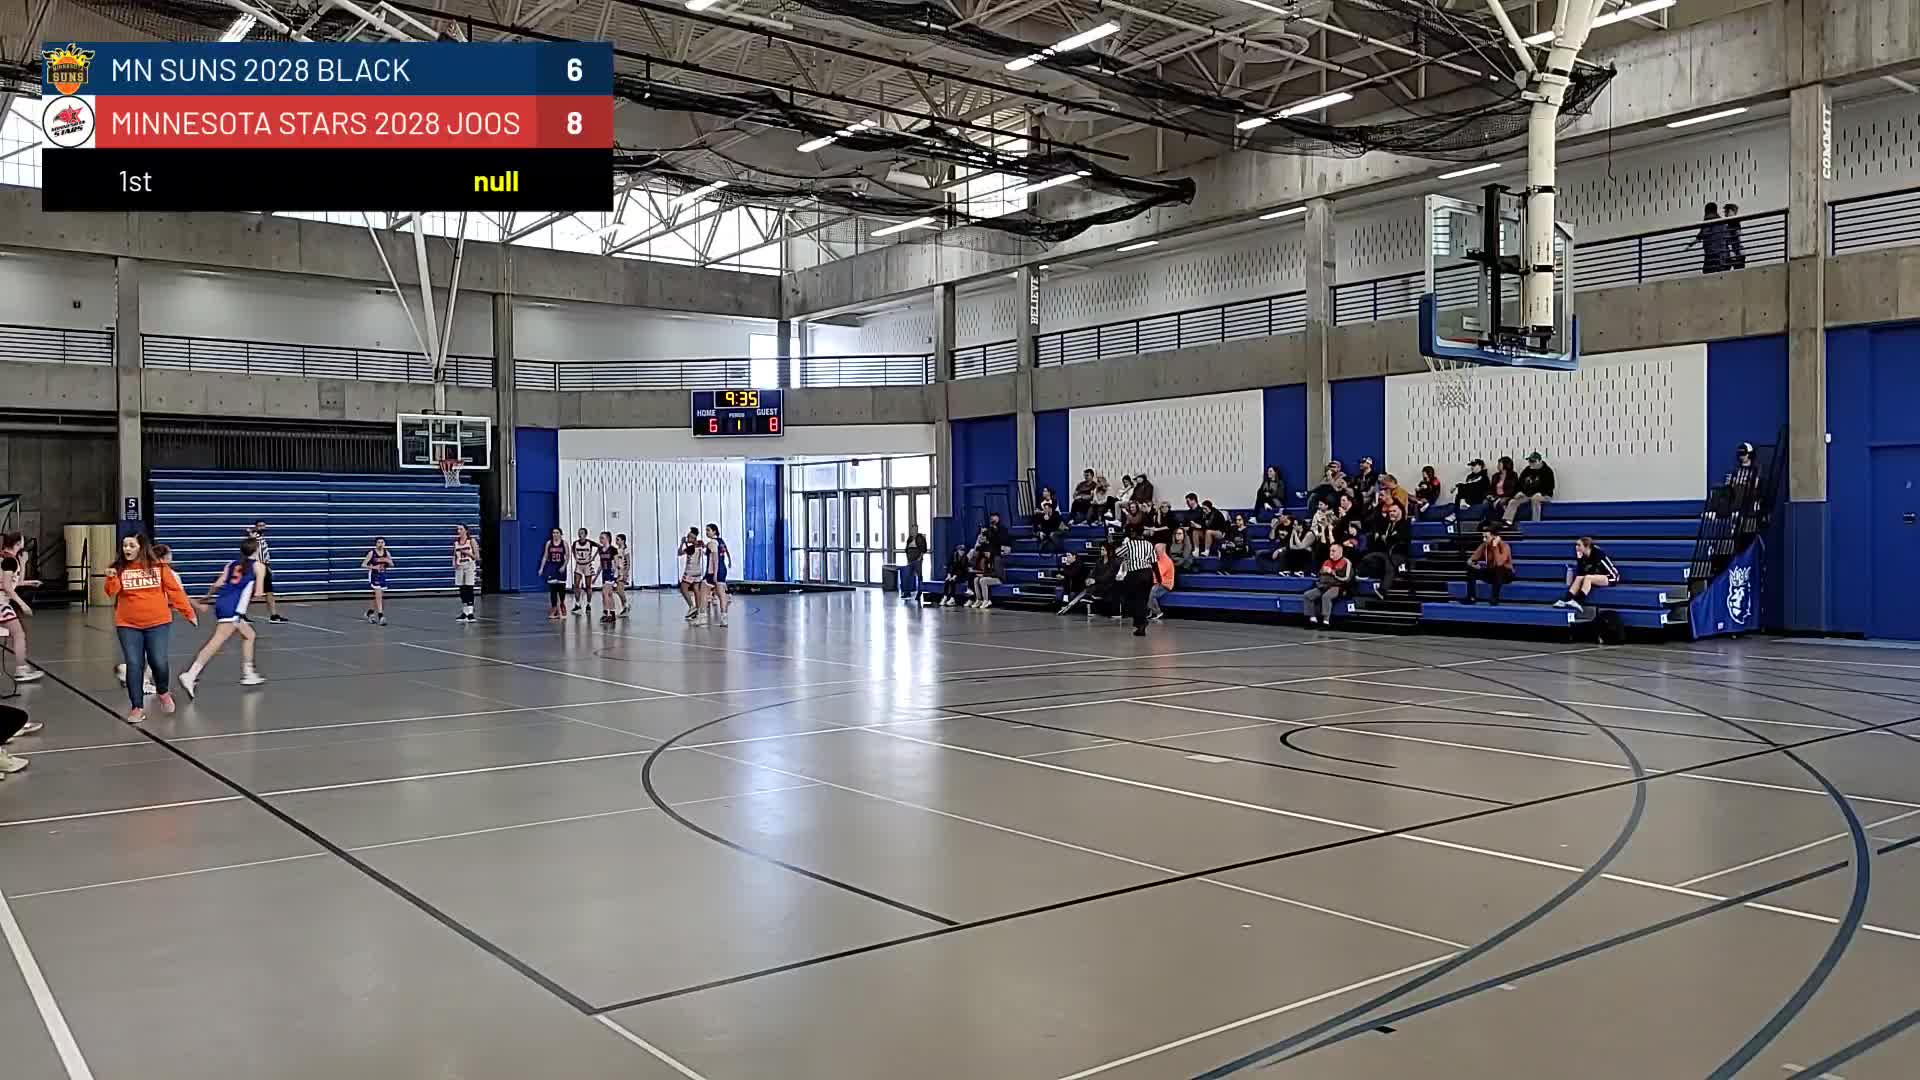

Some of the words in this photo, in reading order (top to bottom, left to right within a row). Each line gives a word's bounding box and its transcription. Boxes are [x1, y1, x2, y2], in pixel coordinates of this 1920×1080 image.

[725, 391, 758, 406] 9:35
[696, 409, 716, 417] HOME
[756, 408, 778, 416] GUEST
[709, 418, 718, 432] 6
[769, 417, 778, 432] 8
[128, 498, 136, 508] 5
[122, 577, 161, 588] SUNS
